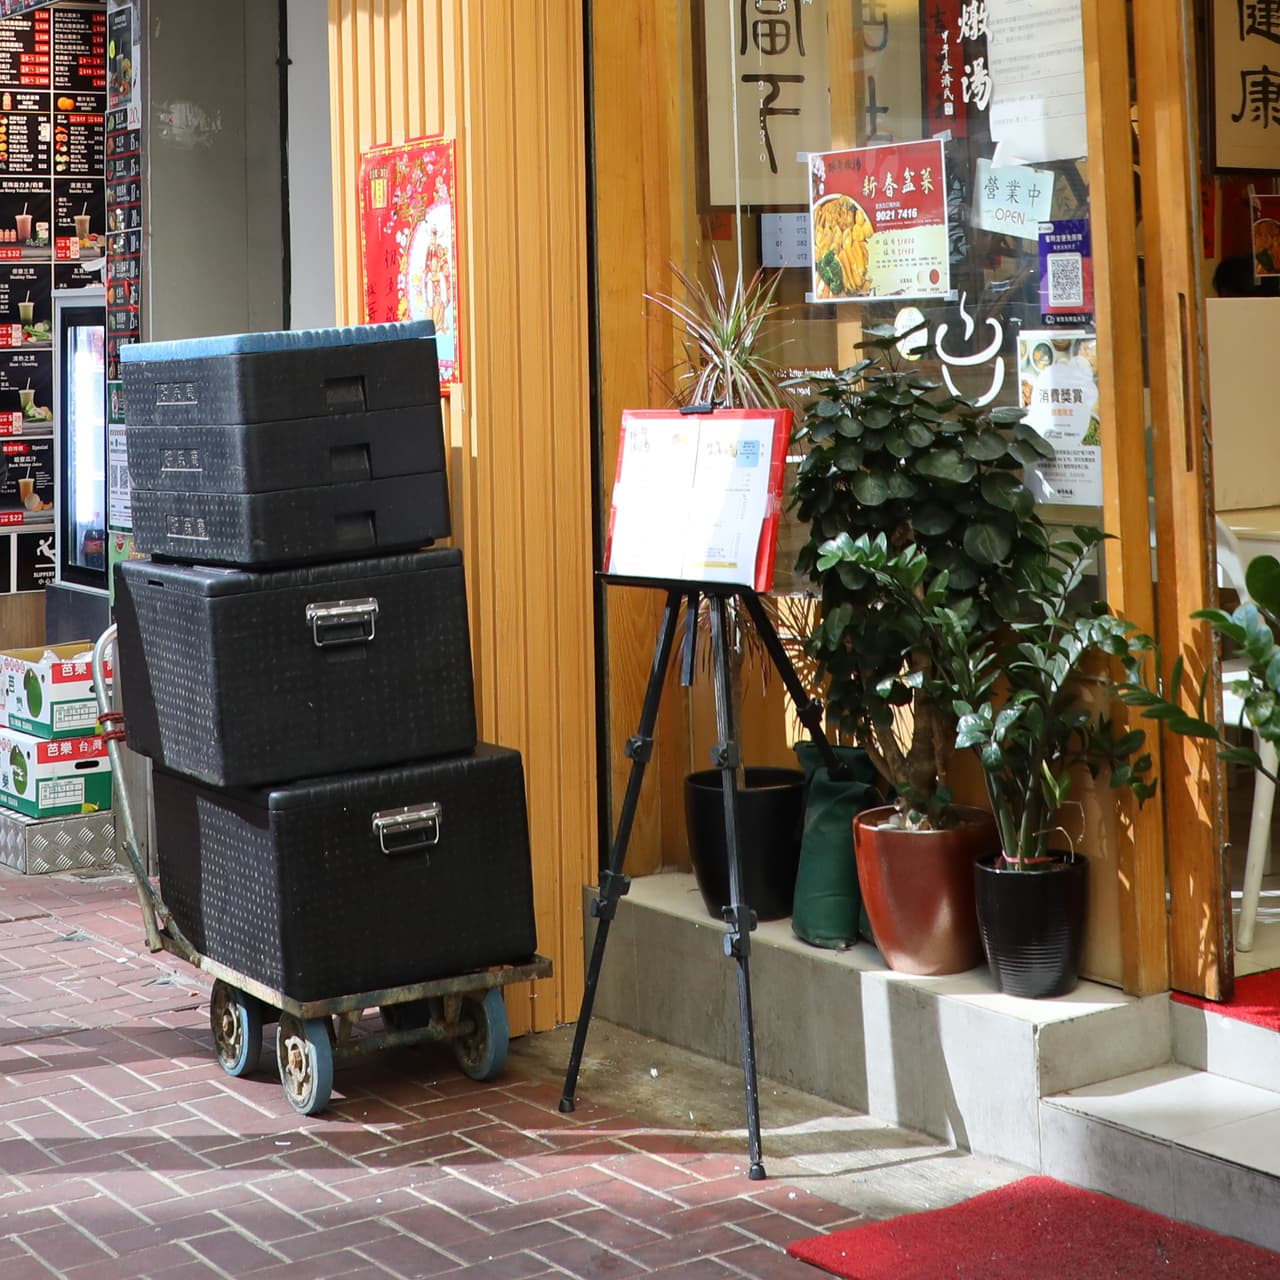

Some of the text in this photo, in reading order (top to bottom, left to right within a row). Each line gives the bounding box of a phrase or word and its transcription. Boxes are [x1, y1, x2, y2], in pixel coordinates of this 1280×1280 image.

[862, 167, 935, 200] 新春盆菜
[983, 175, 1042, 208] 營業中
[875, 207, 918, 222] 9021 7416
[995, 207, 1026, 226] OPEN
[47, 743, 72, 757] 芭樂
